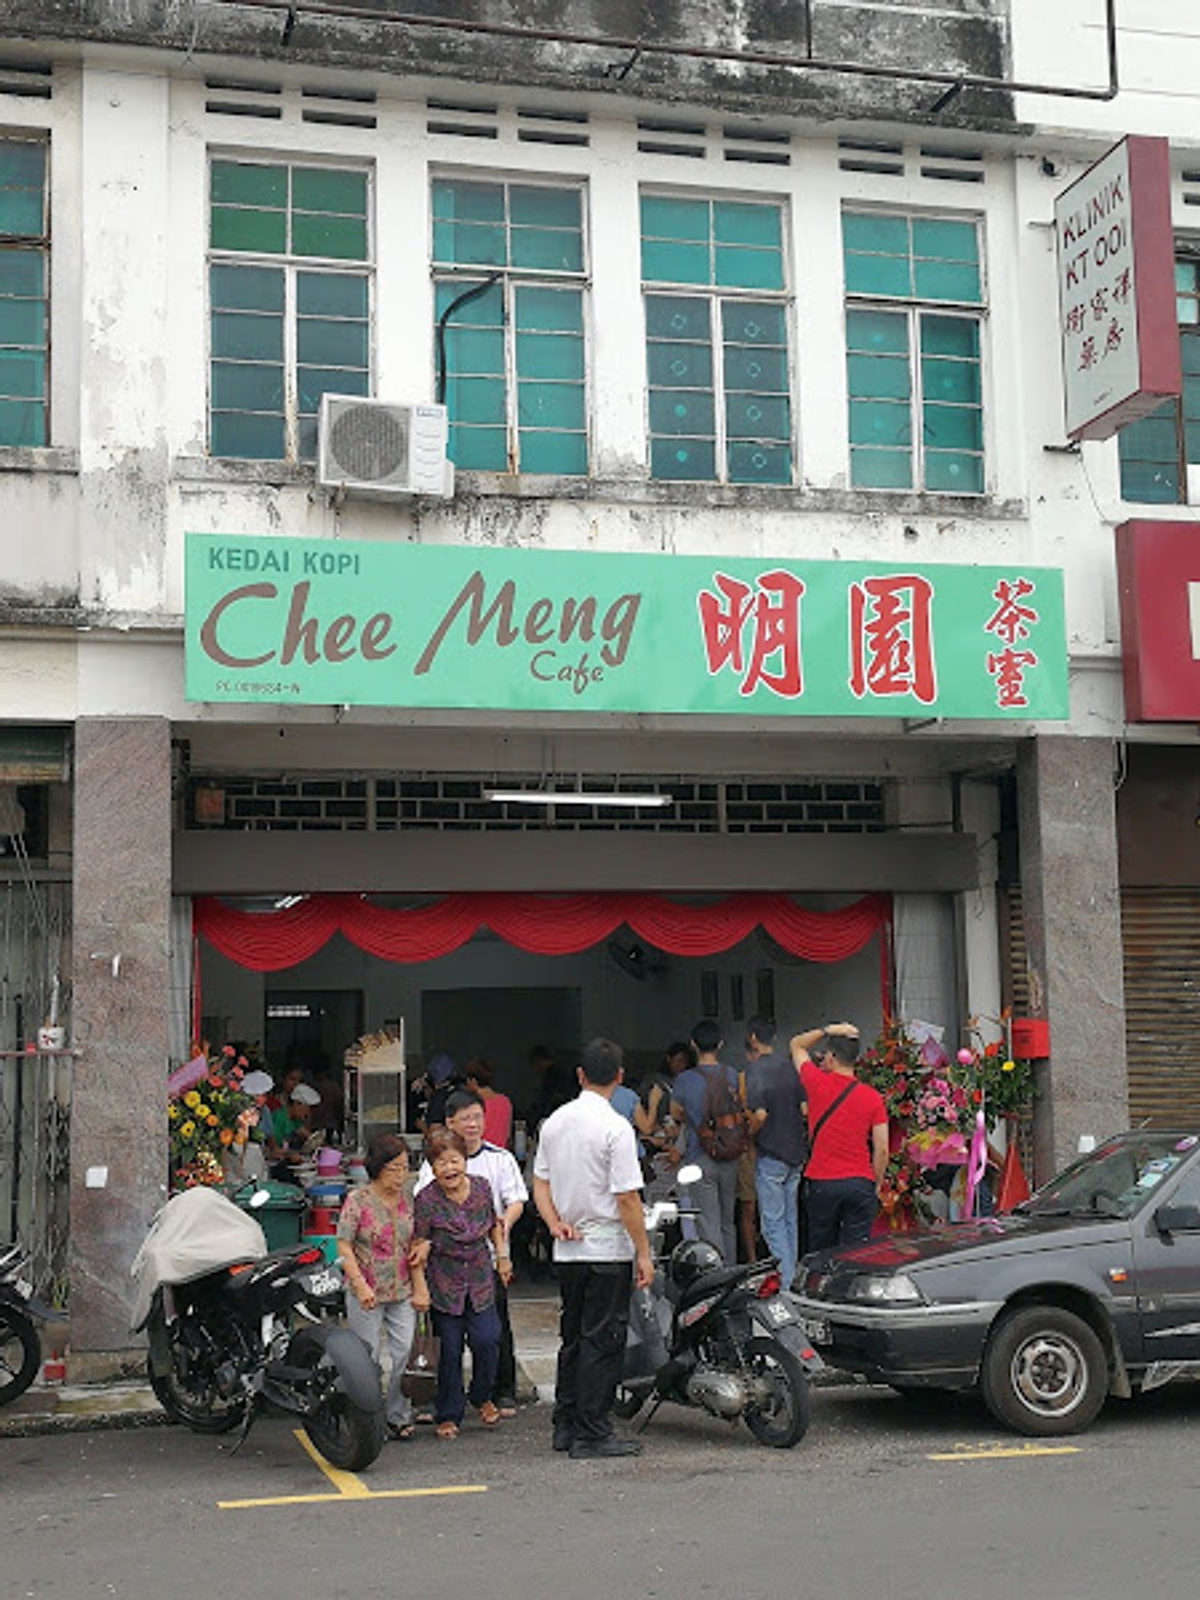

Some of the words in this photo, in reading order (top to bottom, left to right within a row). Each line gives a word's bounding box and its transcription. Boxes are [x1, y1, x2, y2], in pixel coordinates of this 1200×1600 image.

[1063, 174, 1124, 249] KLINIK
[1066, 248, 1089, 290] KT
[1094, 218, 1127, 266] OOI
[209, 547, 289, 573] KEDAI
[303, 551, 359, 575] KOPI
[200, 581, 397, 668] Chee
[414, 570, 641, 676] Meng
